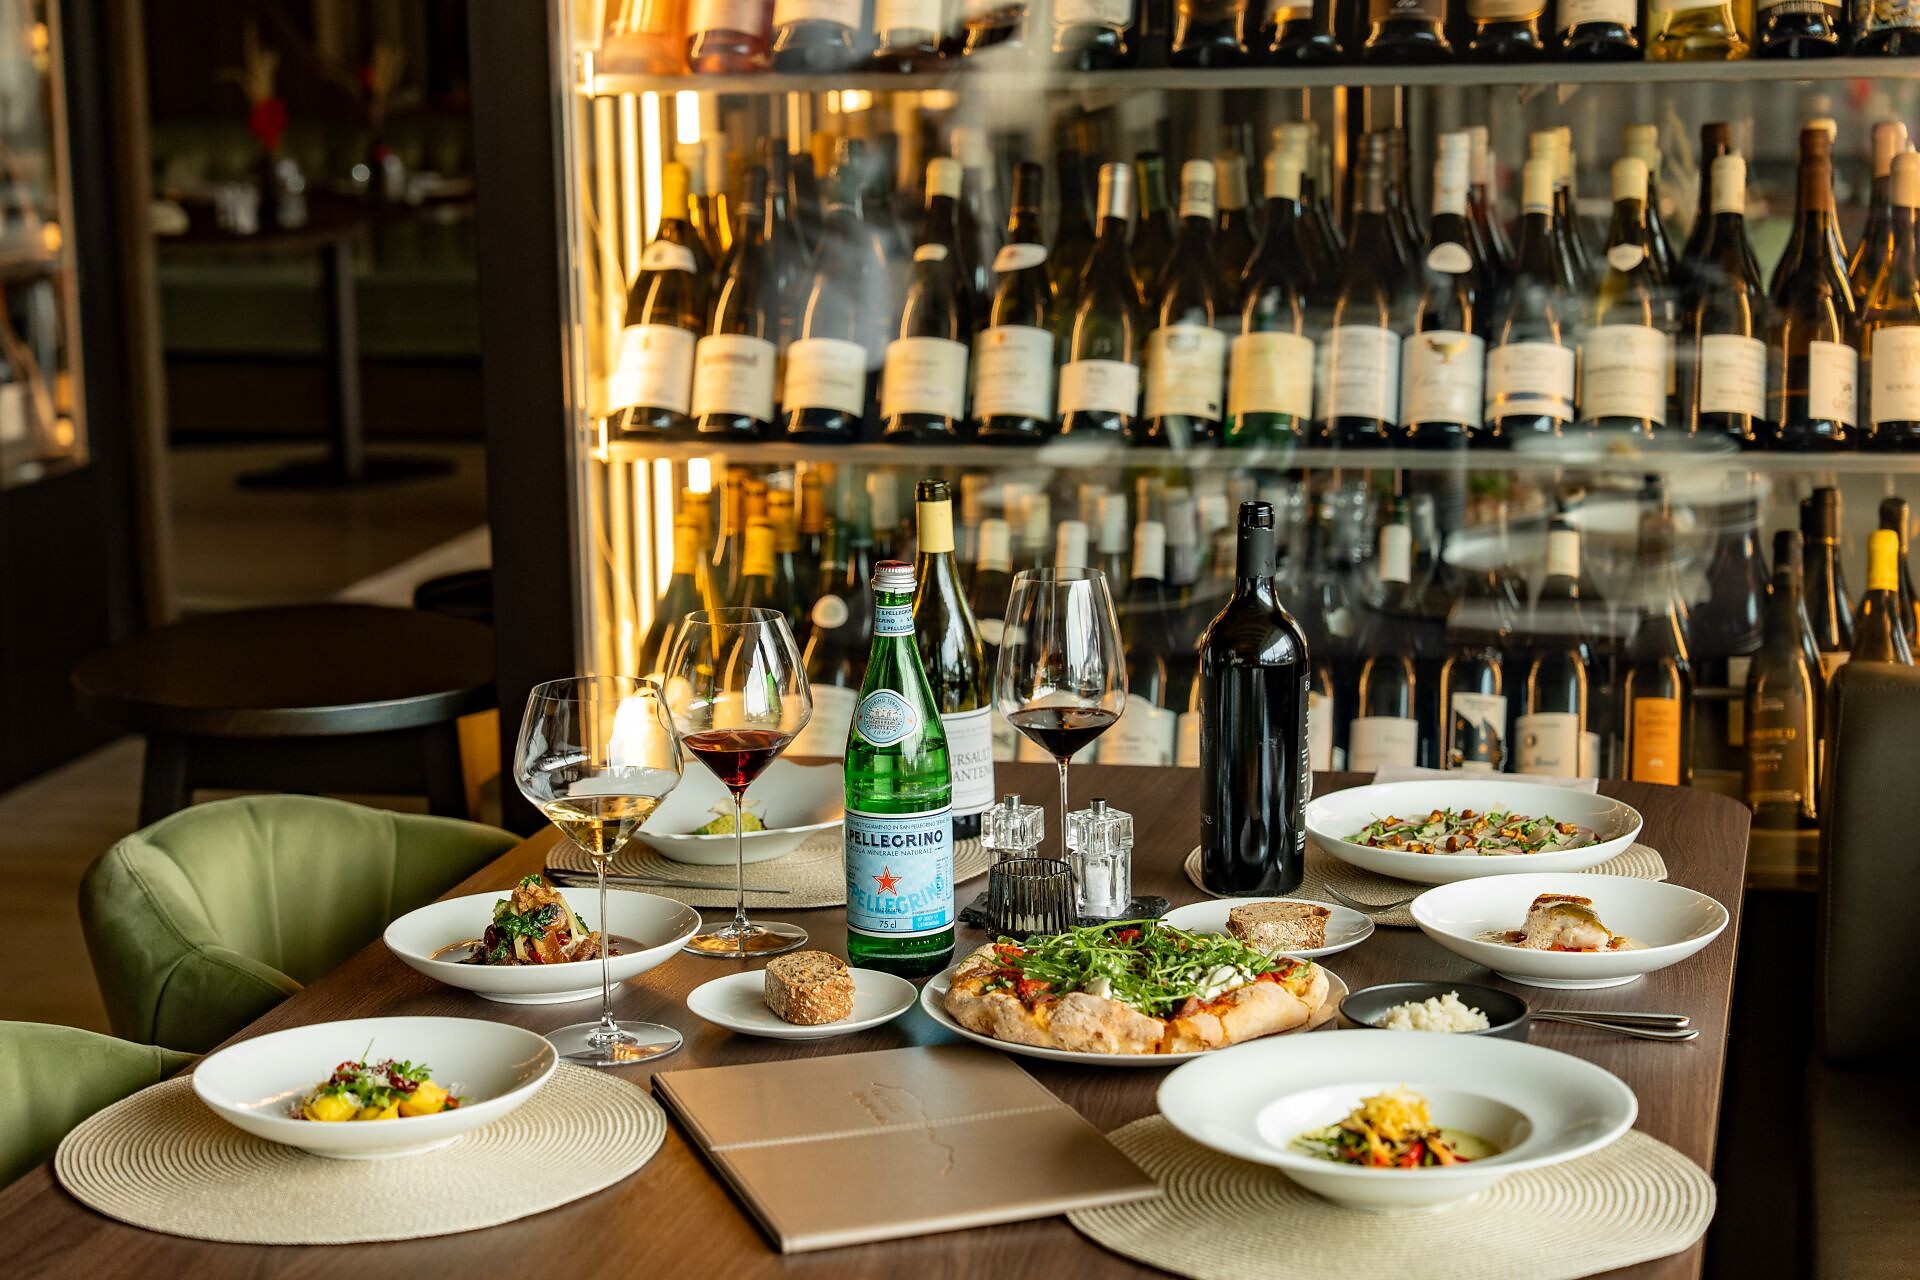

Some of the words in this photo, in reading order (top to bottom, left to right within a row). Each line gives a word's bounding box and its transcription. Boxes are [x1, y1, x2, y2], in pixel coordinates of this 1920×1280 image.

[900, 848, 932, 856] NATURALE
[879, 920, 889, 929] 75
[890, 920, 897, 929] cl
